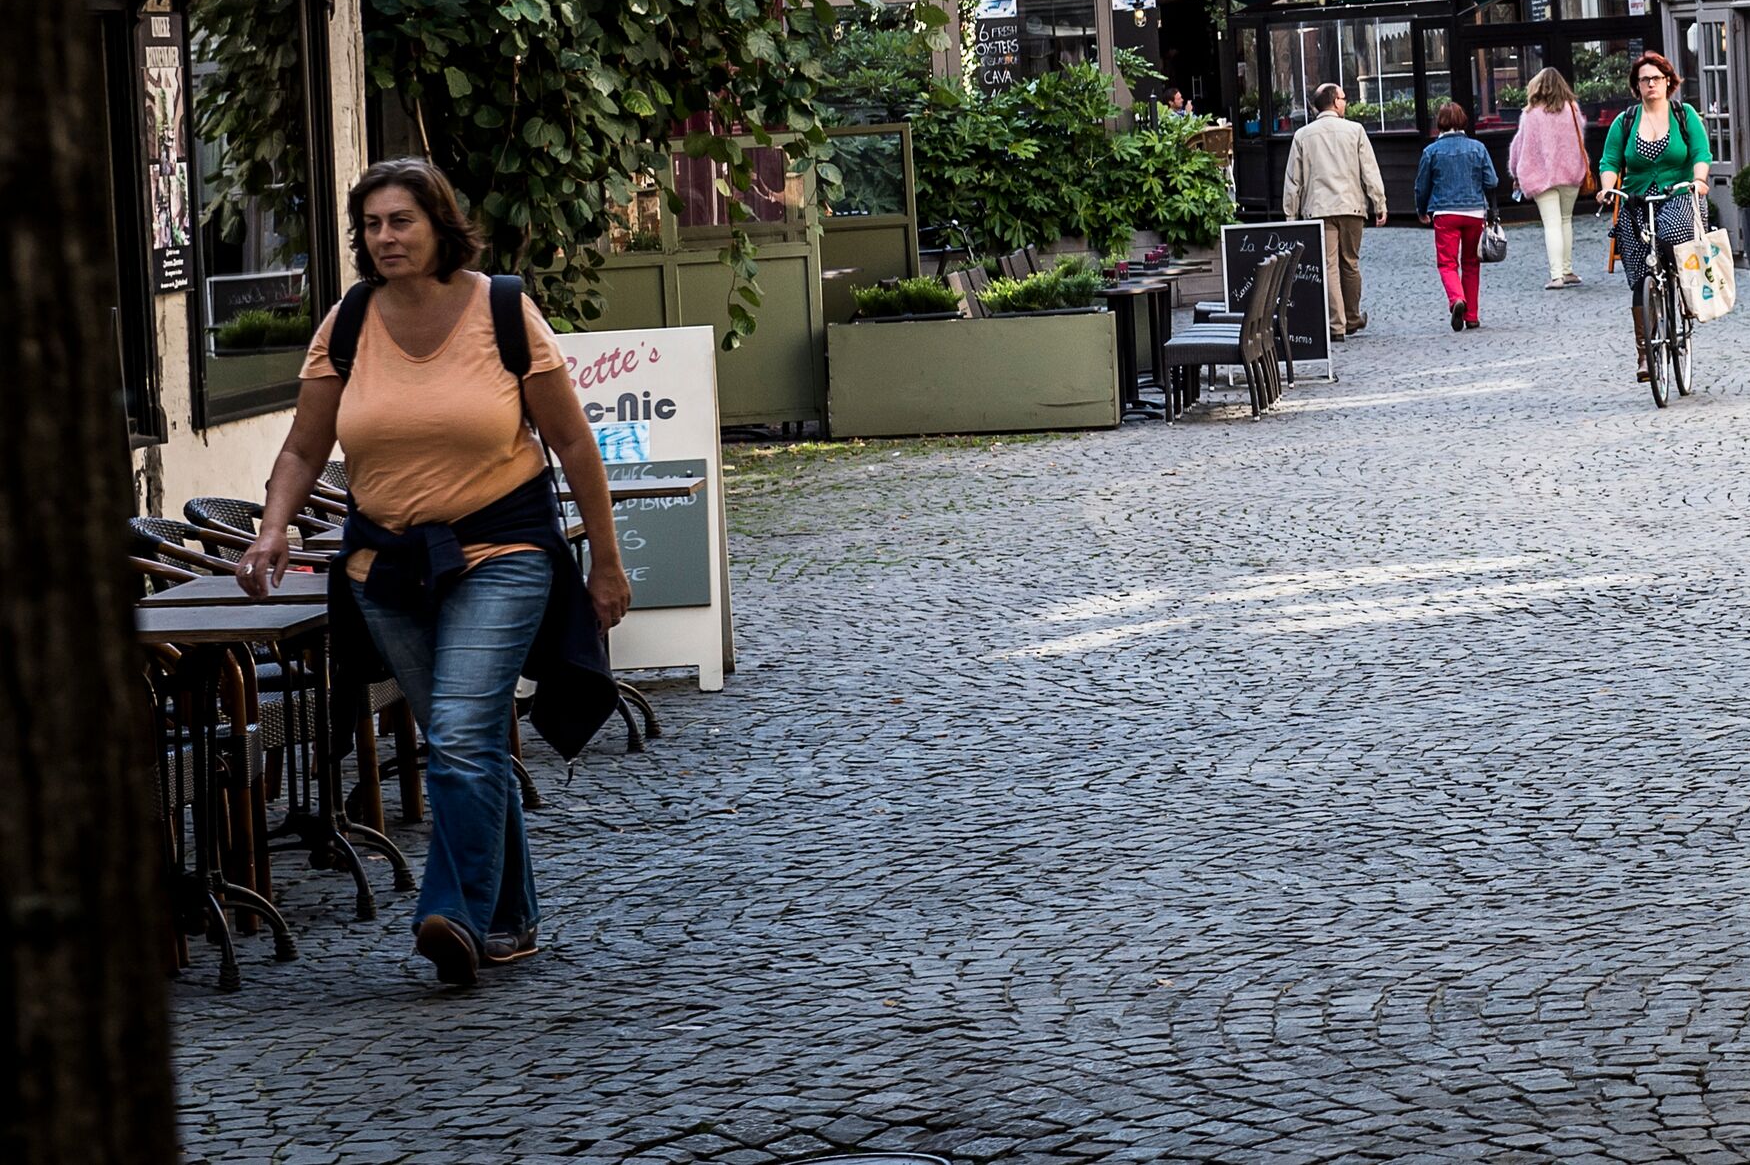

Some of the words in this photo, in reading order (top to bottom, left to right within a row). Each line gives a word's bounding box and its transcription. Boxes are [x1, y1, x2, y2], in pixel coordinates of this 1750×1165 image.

[979, 23, 989, 42] 6
[992, 25, 1018, 38] FRESH
[975, 39, 1019, 55] OYSTERS
[983, 70, 1013, 85] CAVA
[1240, 235, 1256, 252] La
[1264, 232, 1297, 251] Dou
